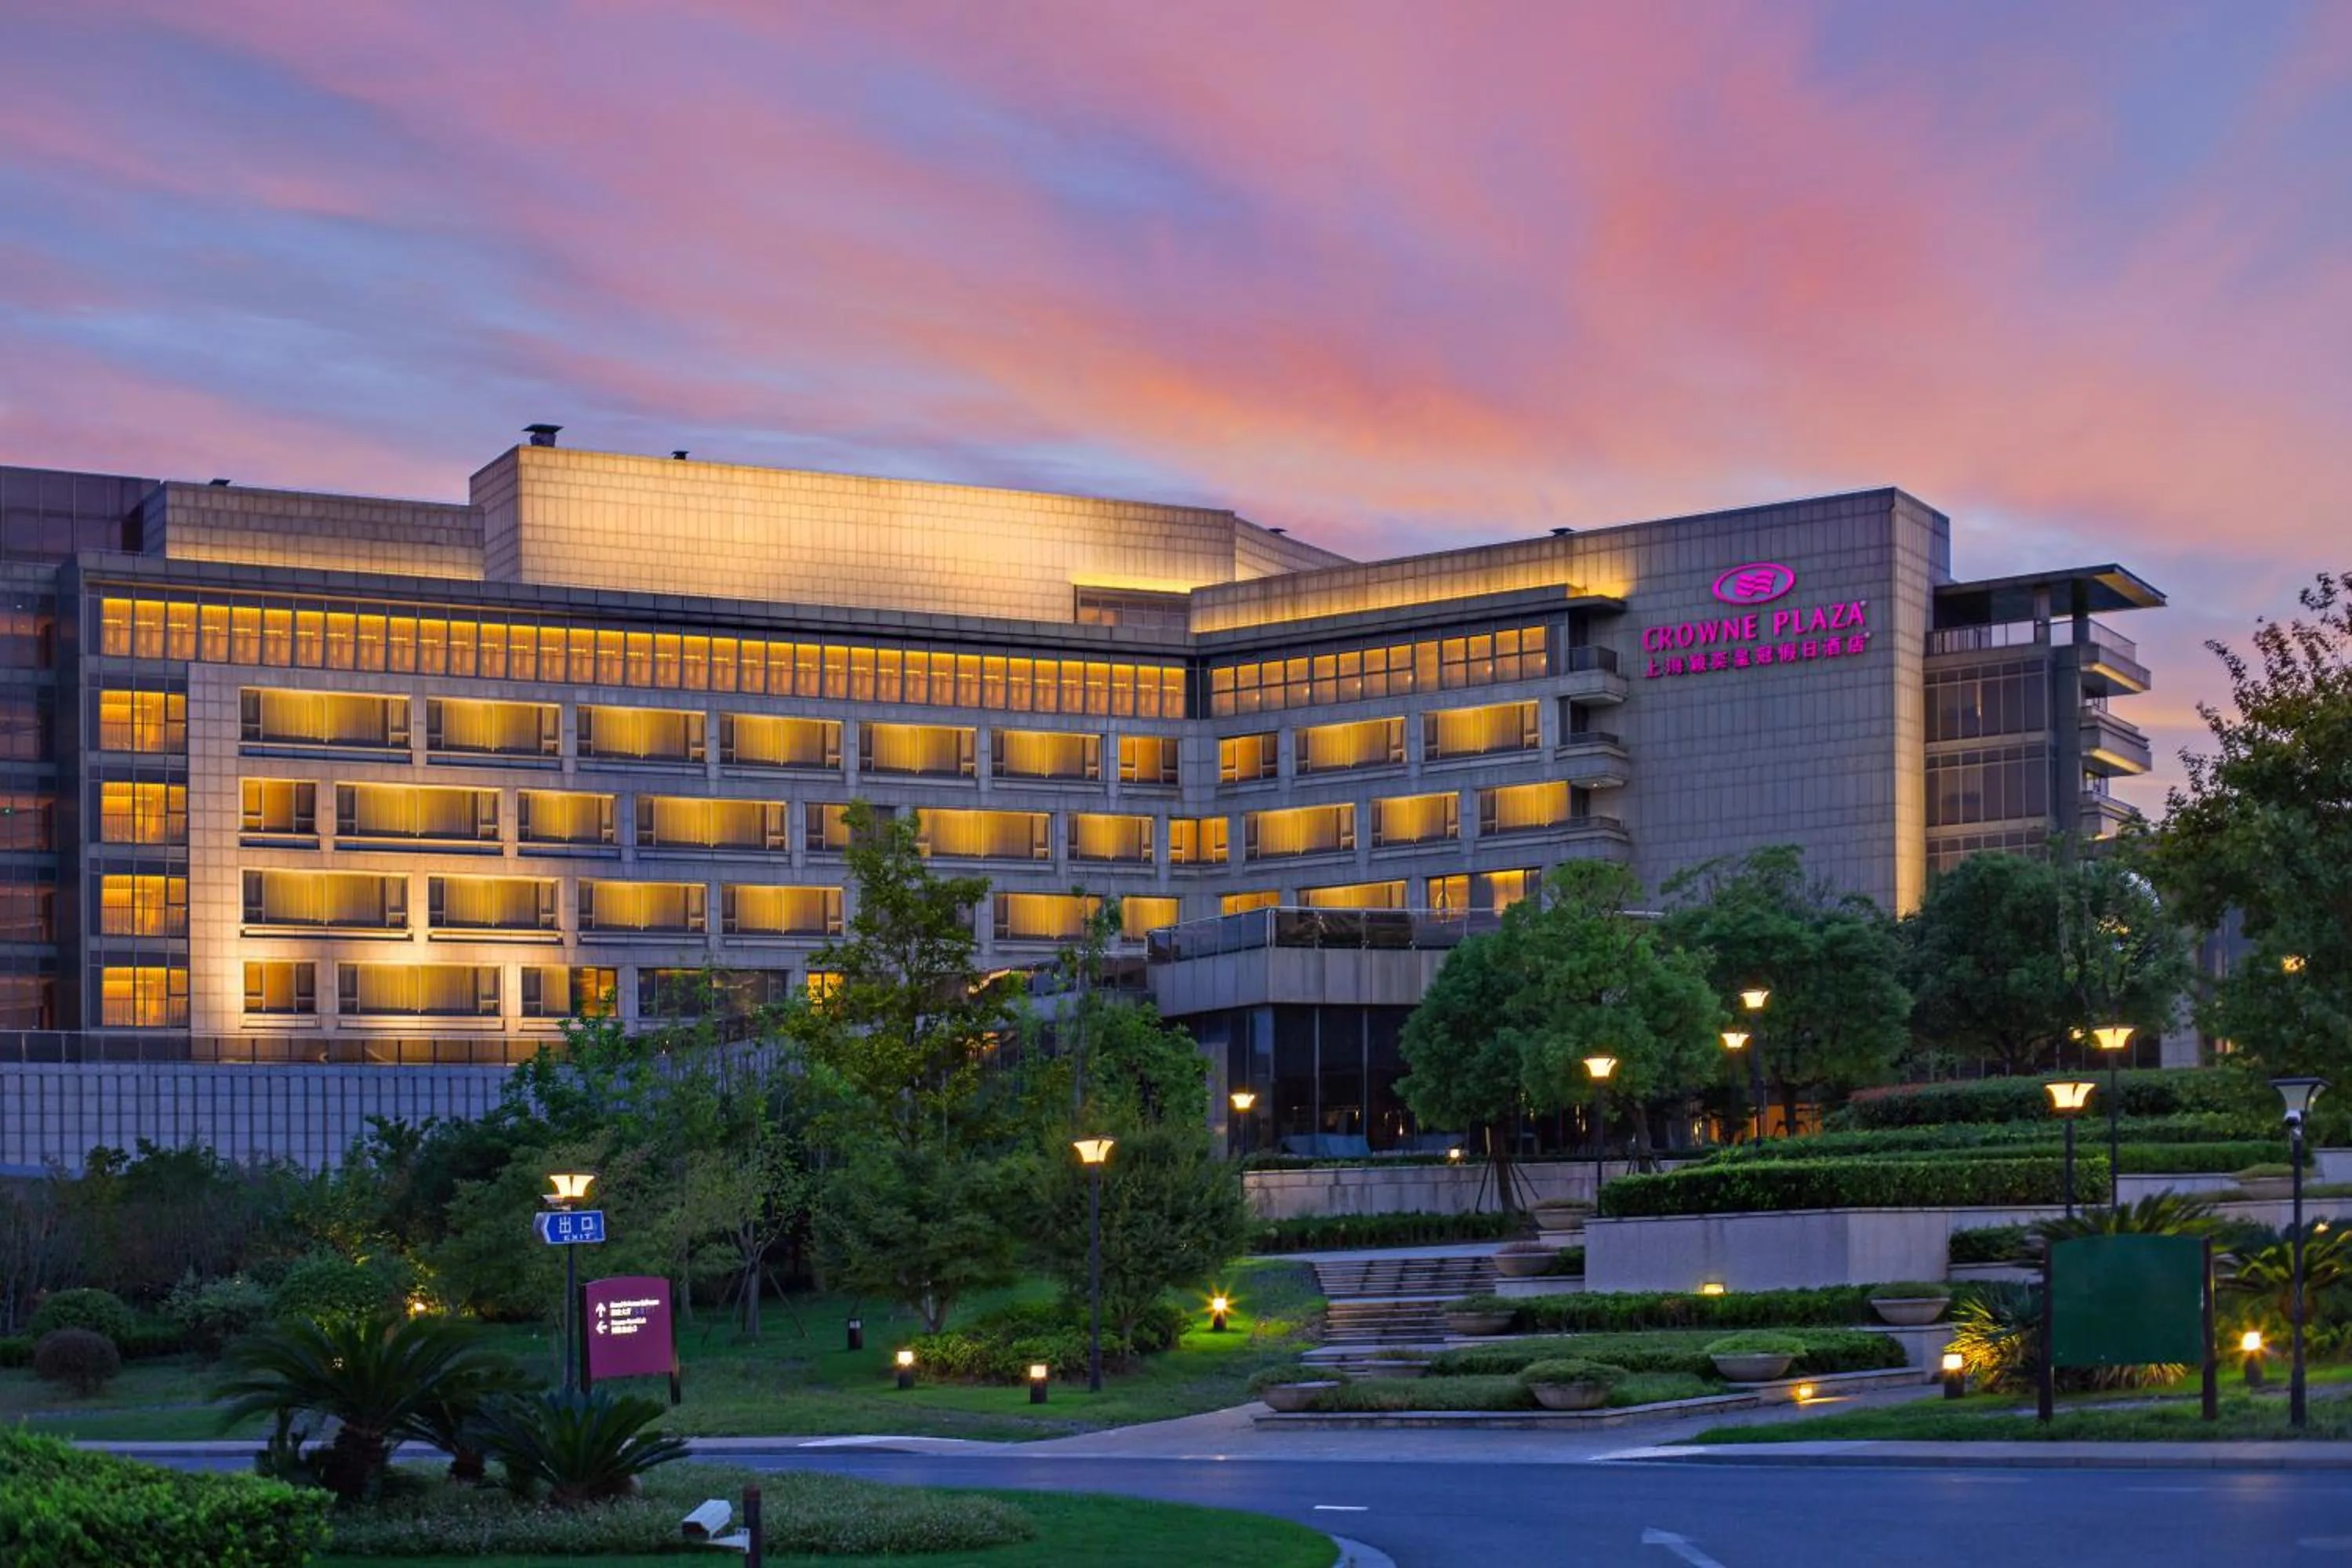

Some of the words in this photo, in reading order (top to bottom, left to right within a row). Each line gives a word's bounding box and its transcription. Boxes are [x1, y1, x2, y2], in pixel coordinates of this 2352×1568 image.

[1643, 613, 1758, 652] CROWNE
[1773, 602, 1864, 637] PLAZA
[559, 1216, 593, 1234] 出口
